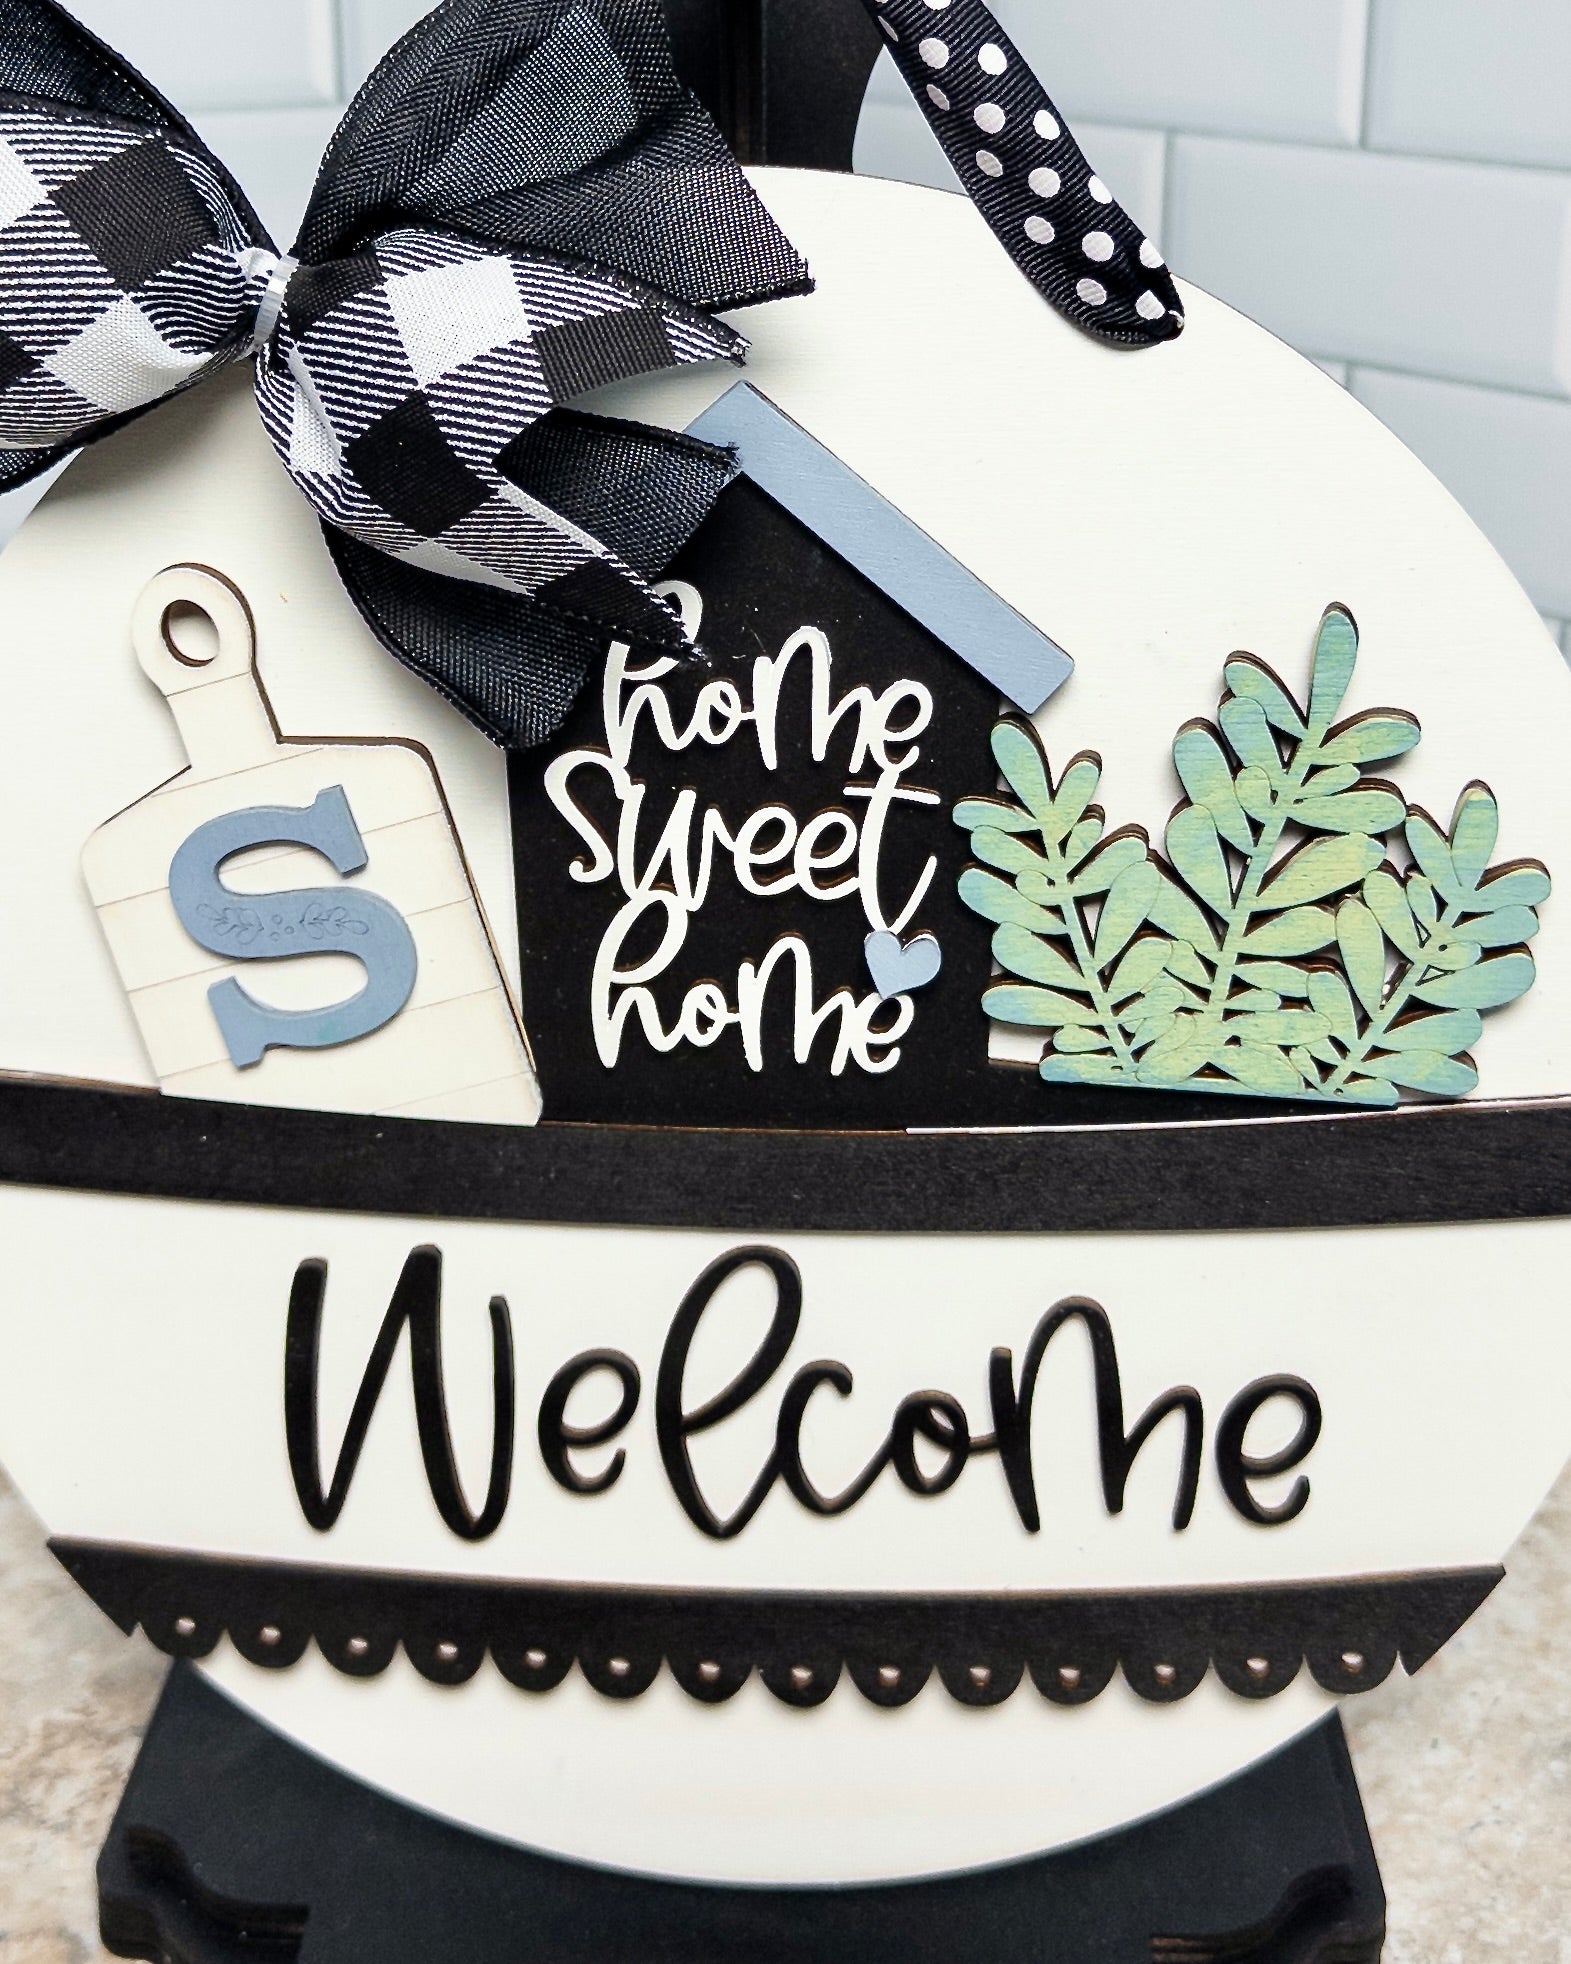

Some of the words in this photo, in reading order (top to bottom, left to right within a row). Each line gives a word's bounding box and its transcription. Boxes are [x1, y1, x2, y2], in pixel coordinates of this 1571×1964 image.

[602, 579, 933, 771] home
[168, 784, 418, 1069] S
[591, 889, 915, 1076] home
[285, 1244, 1322, 1541] Welcome
